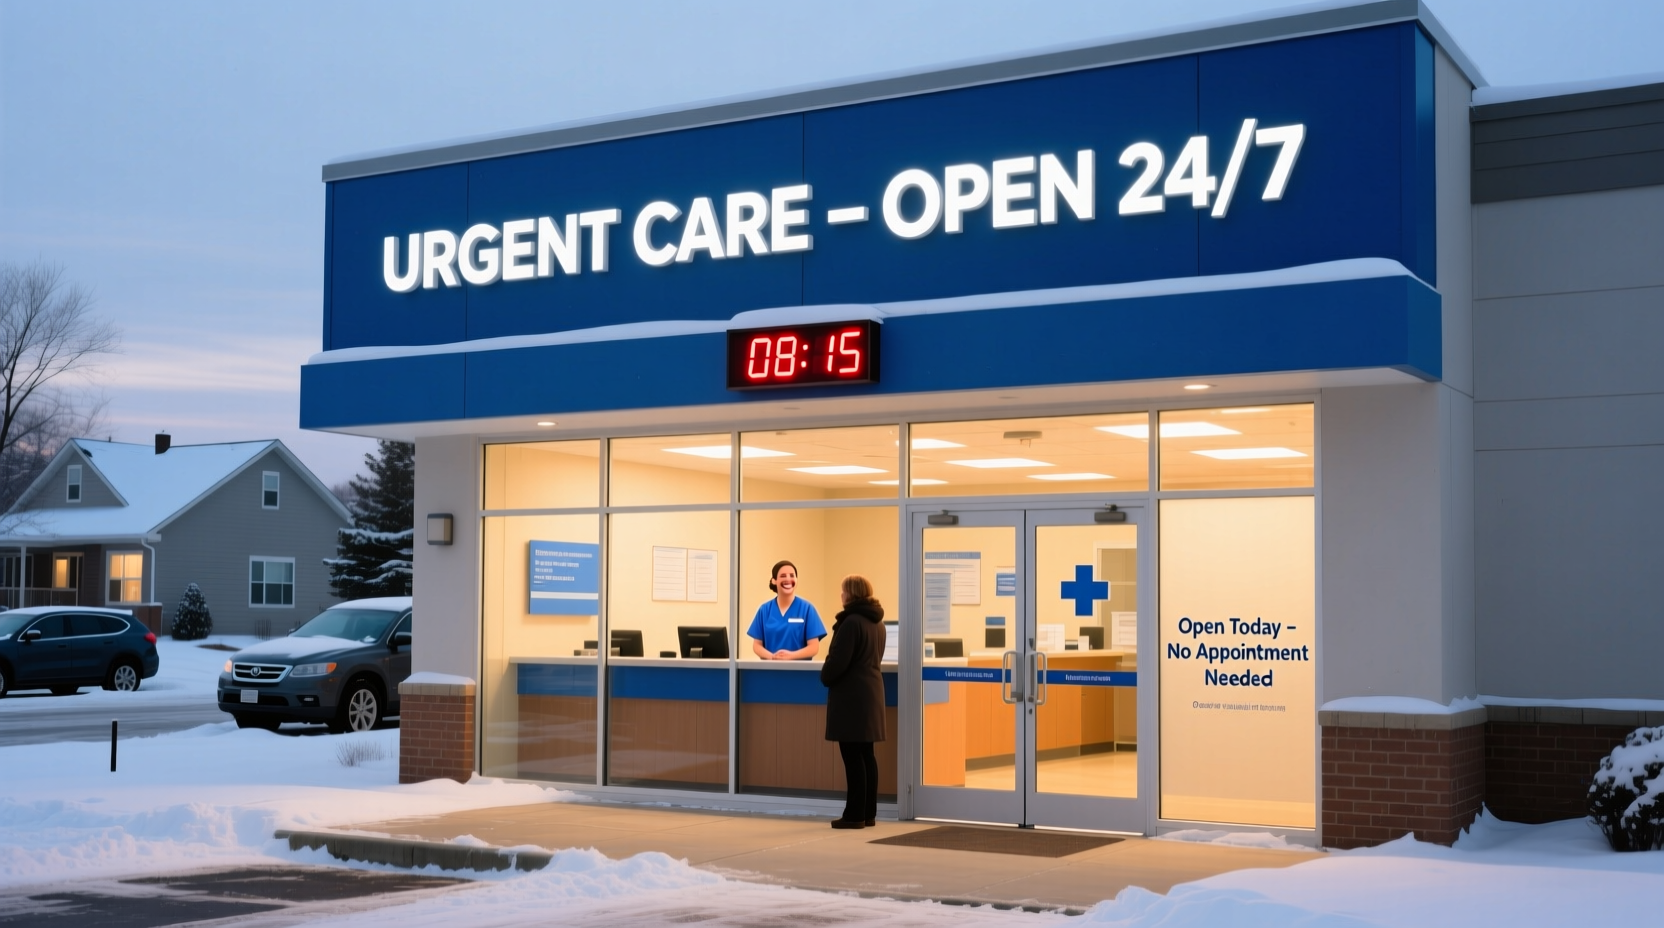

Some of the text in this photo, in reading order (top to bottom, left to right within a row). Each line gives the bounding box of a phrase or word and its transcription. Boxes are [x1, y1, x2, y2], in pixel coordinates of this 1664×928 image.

[383, 208, 621, 293] URGENT
[633, 184, 814, 266] CARE
[882, 149, 1096, 240] OPEN
[1118, 118, 1306, 219] 24/7
[748, 330, 861, 379] 08:15
[1178, 617, 1225, 639] Open
[1229, 617, 1282, 640] Today
[1167, 642, 1310, 664] No Appointment
[1205, 668, 1273, 687] Needed
